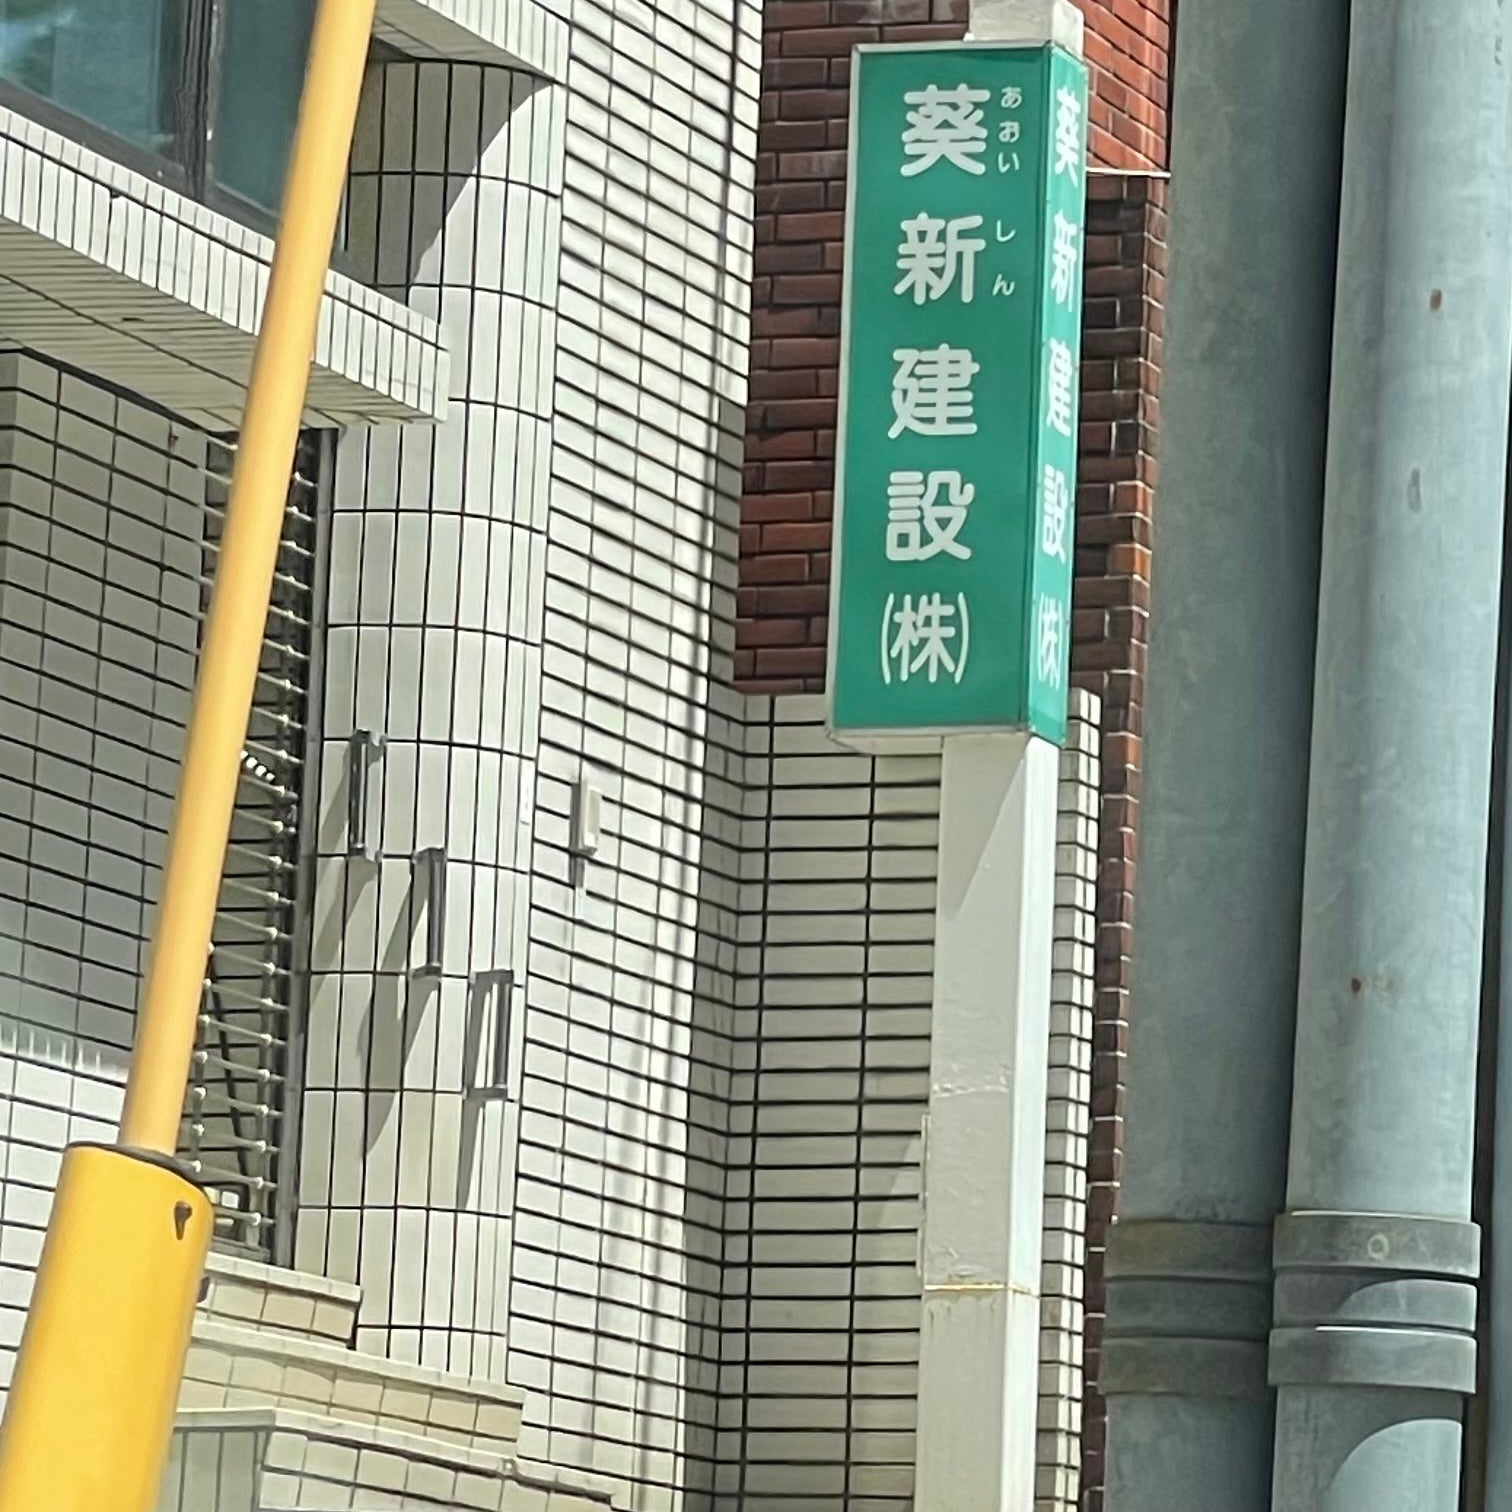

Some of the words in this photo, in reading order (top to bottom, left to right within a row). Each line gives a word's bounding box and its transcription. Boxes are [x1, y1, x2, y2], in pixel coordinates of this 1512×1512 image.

[880, 83, 991, 685] 葵新建設(株)
